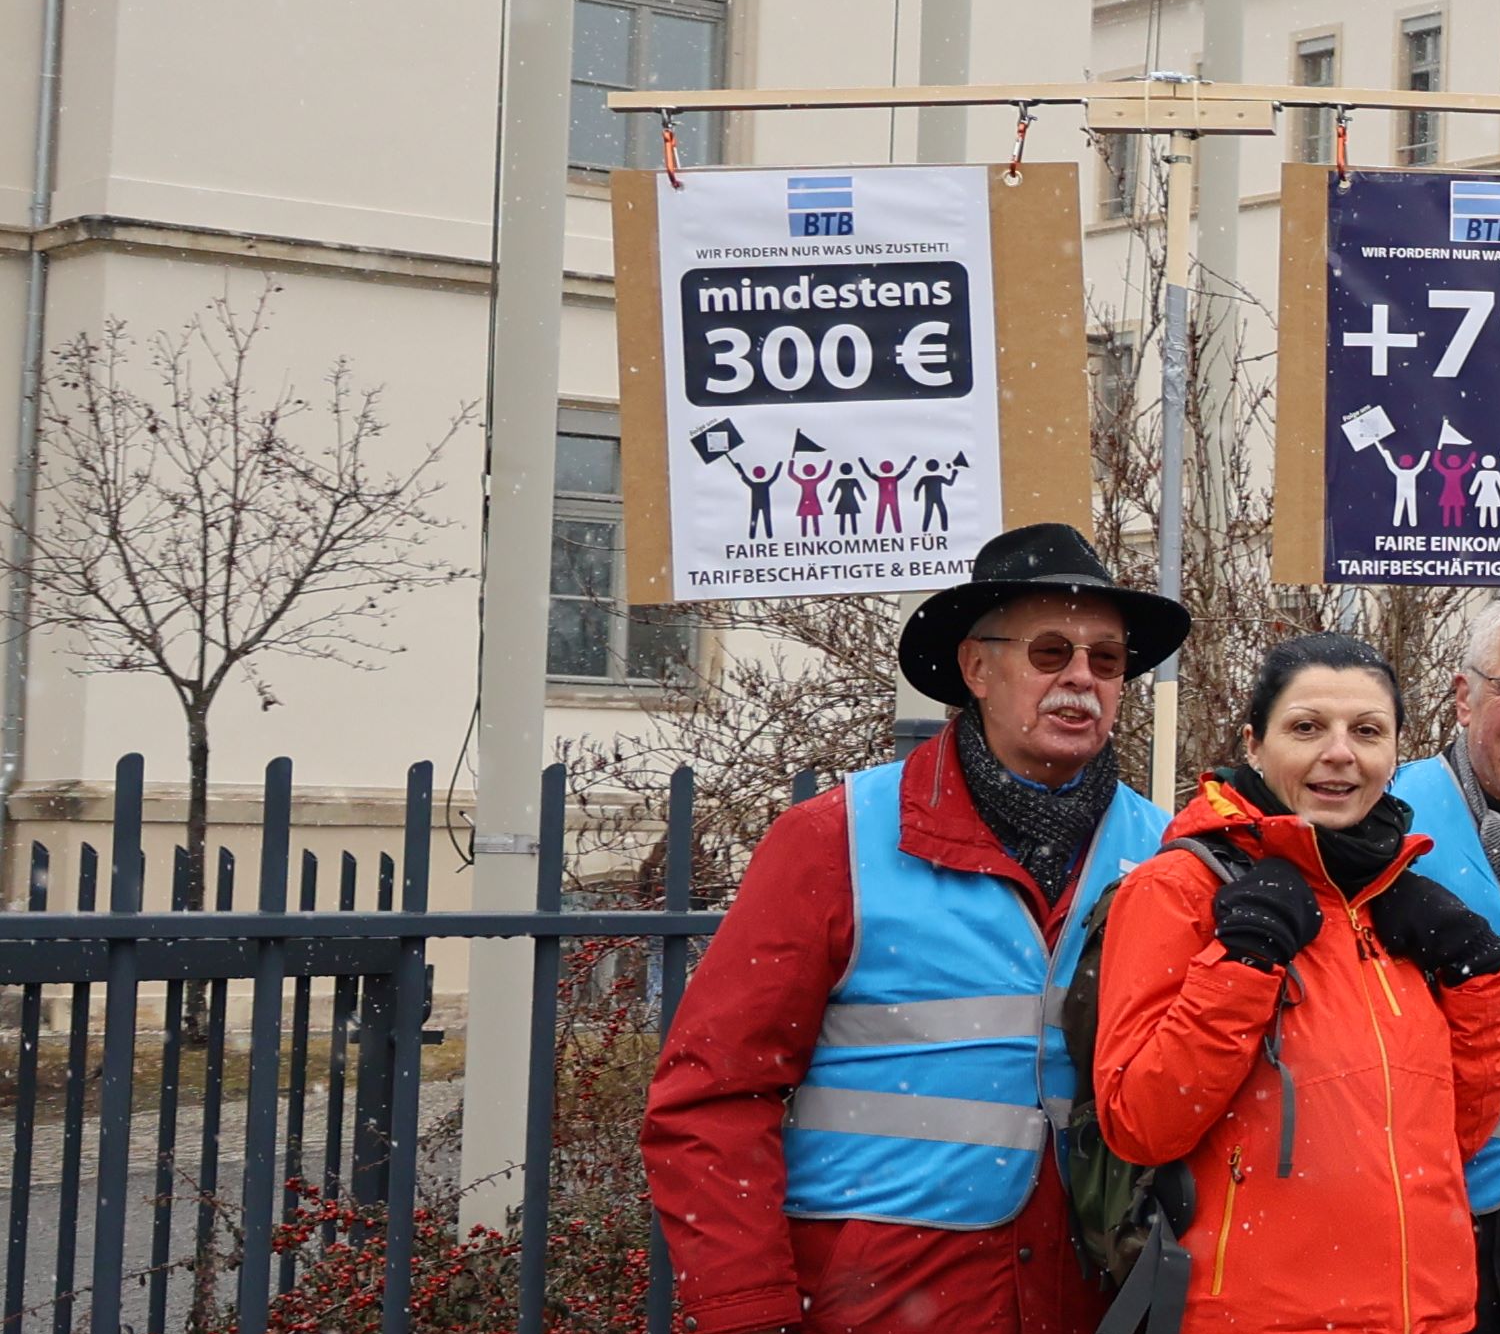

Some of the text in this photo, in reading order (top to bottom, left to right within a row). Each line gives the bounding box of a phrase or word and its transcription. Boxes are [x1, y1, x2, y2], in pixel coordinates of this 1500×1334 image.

[804, 212, 853, 236] BTB
[696, 242, 949, 259] WIR FORDERN NUR WAS UNS ZUSTEHT!
[1361, 247, 1387, 258] WIR
[1389, 248, 1450, 259] FORDERN
[1453, 249, 1480, 260] NUR
[698, 275, 952, 314] mindestens
[705, 321, 953, 393] 300 €
[726, 535, 948, 559] FAIRE EINKOMMEN FÜR
[1375, 536, 1426, 552] FAIRE
[689, 559, 976, 586] TARIFBESCHÄFTIGTE & BEAMT
